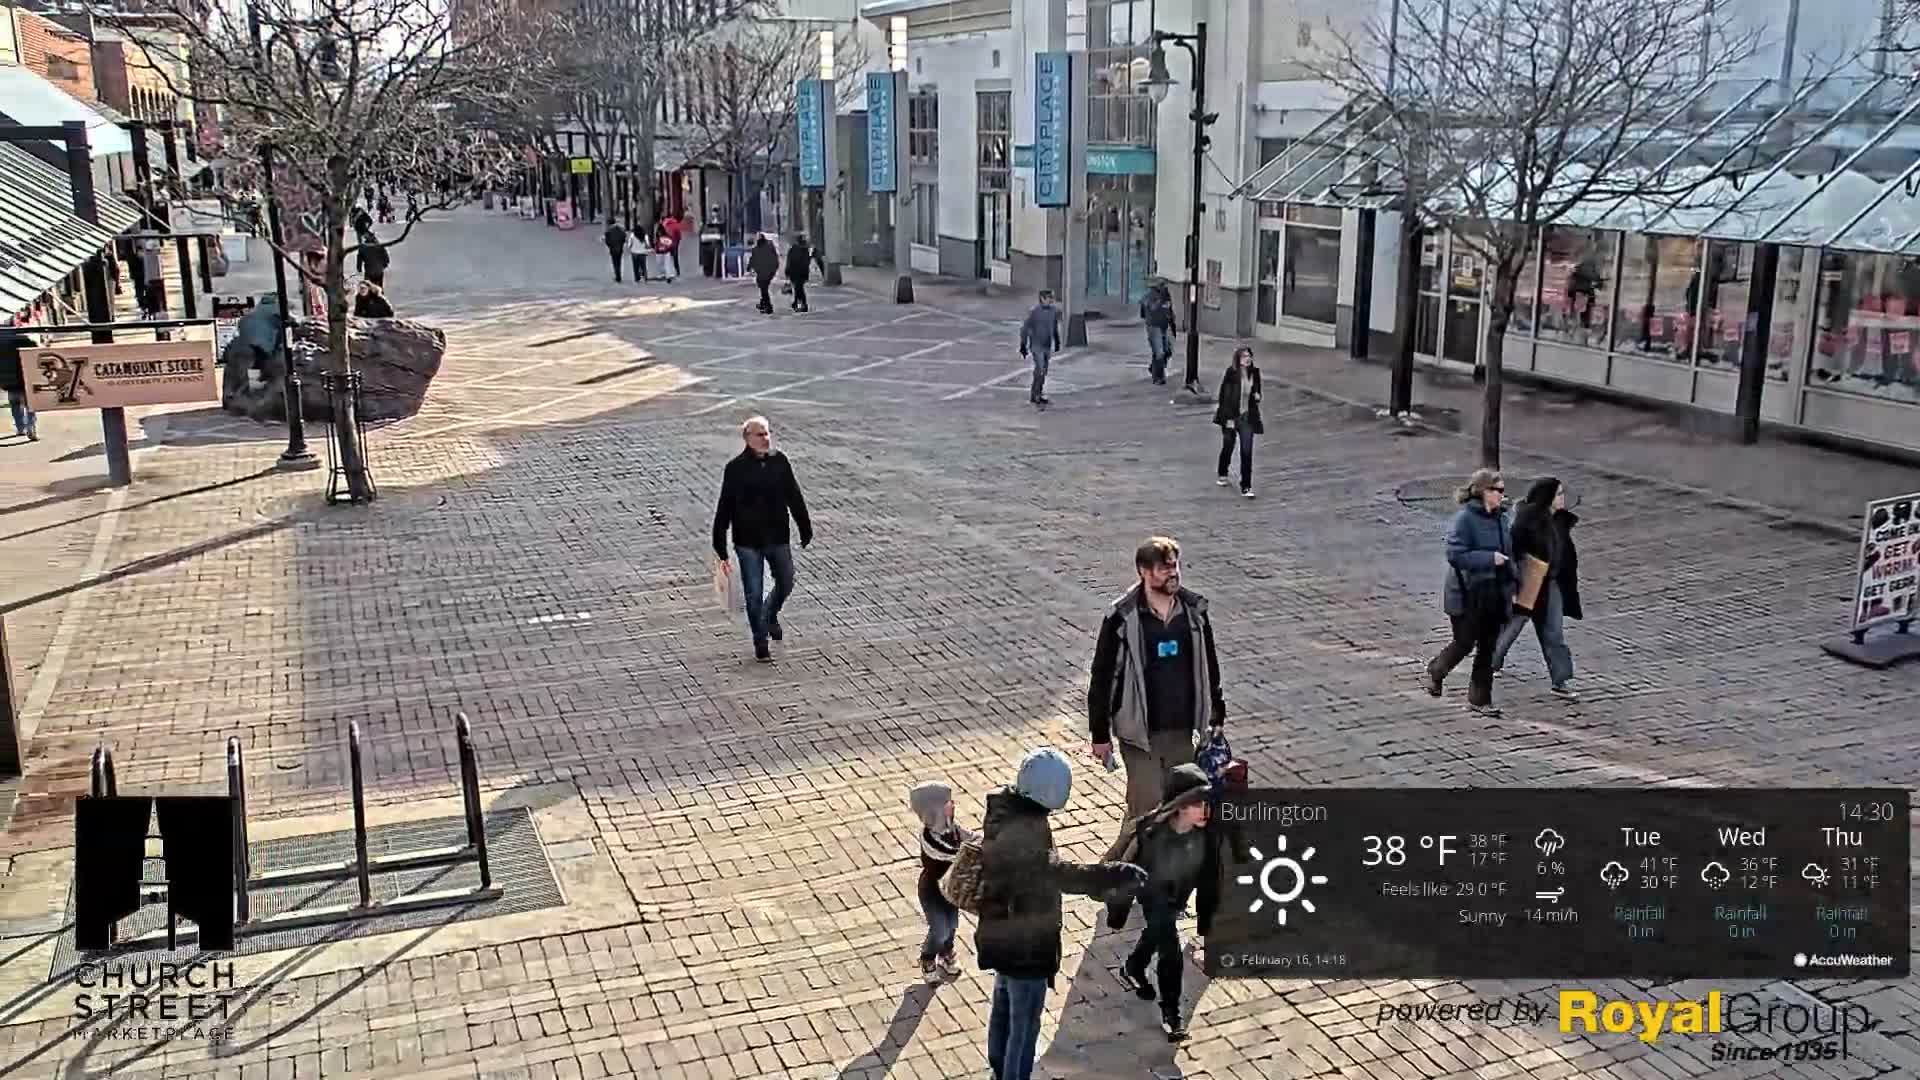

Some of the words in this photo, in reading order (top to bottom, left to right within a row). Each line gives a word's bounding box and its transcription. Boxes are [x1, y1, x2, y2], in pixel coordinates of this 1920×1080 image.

[870, 79, 882, 186] CITYPLACE
[1040, 59, 1053, 197] CITYPLACE
[95, 360, 163, 376] CATAMOUNT
[168, 358, 203, 372] STORE
[1884, 540, 1909, 559] GET
[1864, 582, 1886, 598] GET
